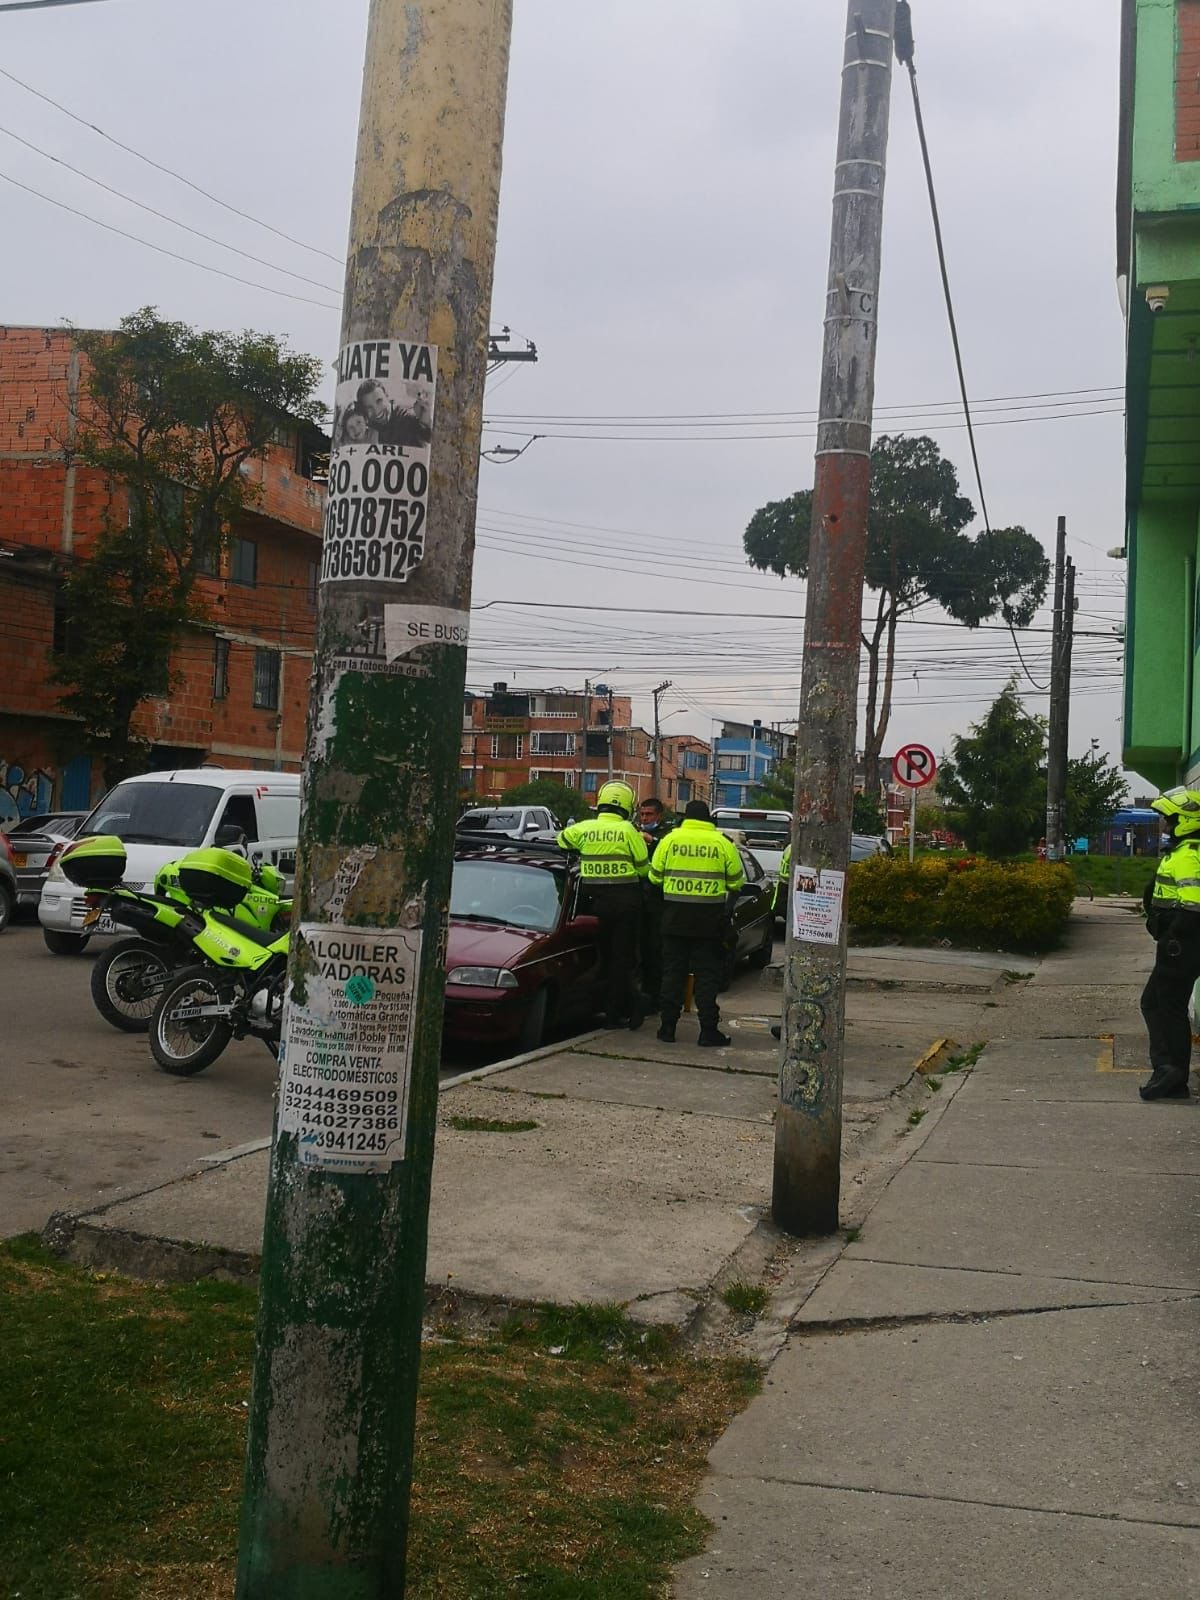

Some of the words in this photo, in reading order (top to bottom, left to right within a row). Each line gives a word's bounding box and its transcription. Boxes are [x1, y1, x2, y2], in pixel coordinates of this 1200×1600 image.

[399, 343, 434, 383] YA
[365, 444, 410, 458] ARL
[328, 458, 428, 498] 80.000
[407, 622, 429, 638] SE
[349, 659, 357, 669] la
[359, 660, 403, 675] fotocopia
[406, 665, 417, 676] de
[907, 751, 927, 780] P
[583, 830, 625, 843] POLICIA
[672, 844, 720, 859] POLICIA
[670, 879, 719, 894] 700472
[375, 989, 410, 1002] Pequeña
[331, 1010, 376, 1021] tomática
[378, 1011, 409, 1022] Grande
[291, 1024, 323, 1038] Lavadora
[360, 1031, 386, 1042] Doble
[389, 1033, 406, 1043] Tina
[306, 1051, 347, 1068] COMPRA
[349, 1055, 383, 1069] VENTA
[292, 1063, 398, 1084] ELECTRODOMÉSTICOS
[286, 1081, 398, 1103] 3044469509
[285, 1095, 398, 1116] 3224839662
[291, 1109, 398, 1130] 44027386
[296, 1127, 387, 1151] 3941245
